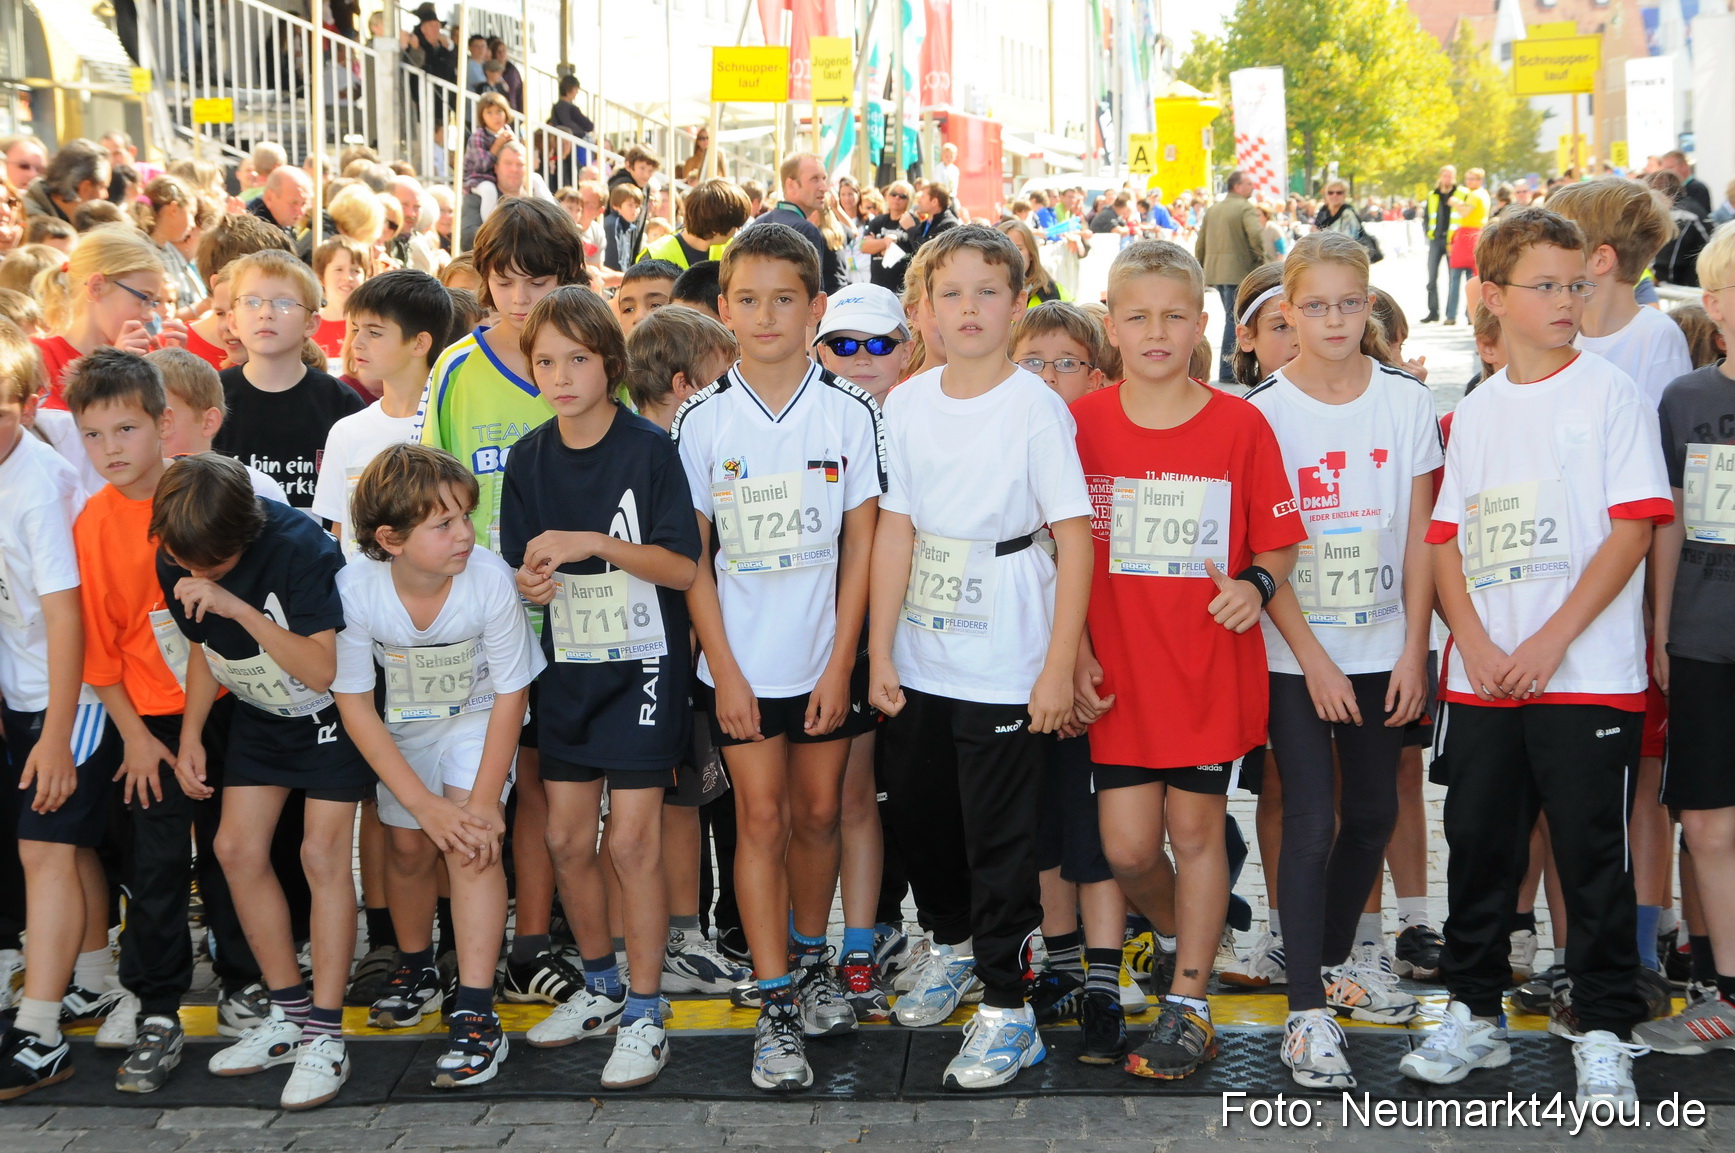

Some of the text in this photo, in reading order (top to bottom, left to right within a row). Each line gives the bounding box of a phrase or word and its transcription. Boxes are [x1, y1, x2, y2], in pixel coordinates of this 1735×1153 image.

[717, 61, 782, 76] Schnupper-
[812, 56, 852, 68] Jugend-
[738, 77, 760, 88] lauf
[823, 69, 842, 80] lauf
[1134, 145, 1149, 166] A
[250, 453, 314, 474] bin ein
[741, 481, 788, 504] Daniel
[1688, 481, 1694, 494] K
[1144, 486, 1185, 507] Henri
[1303, 494, 1339, 509] DKMS
[1484, 496, 1520, 516] Anton
[720, 506, 823, 541] K 7243
[1309, 508, 1382, 523] JEDER EINZELNE ZÄHLT
[1115, 513, 1219, 545] K 7092
[1467, 517, 1558, 553] K 7252
[792, 548, 831, 562] PFLEIDERER
[920, 540, 950, 563] Petar
[1324, 542, 1360, 560] Anna
[1181, 562, 1226, 571] PFLEIDER
[1522, 561, 1569, 573] PFLEIDERER
[919, 569, 983, 604] 7235
[1326, 564, 1394, 596] 7170
[571, 581, 613, 599] Aaron
[553, 602, 651, 634] K 7118
[1368, 604, 1399, 618] PFLEIDERER
[945, 618, 988, 631] PFLEIDERER
[165, 642, 174, 656] K
[415, 640, 485, 669] Sebastian
[620, 641, 665, 655] PFLEIDERER
[225, 664, 266, 676] Josua
[391, 661, 490, 694] K 7055
[994, 723, 1019, 733] JAKO
